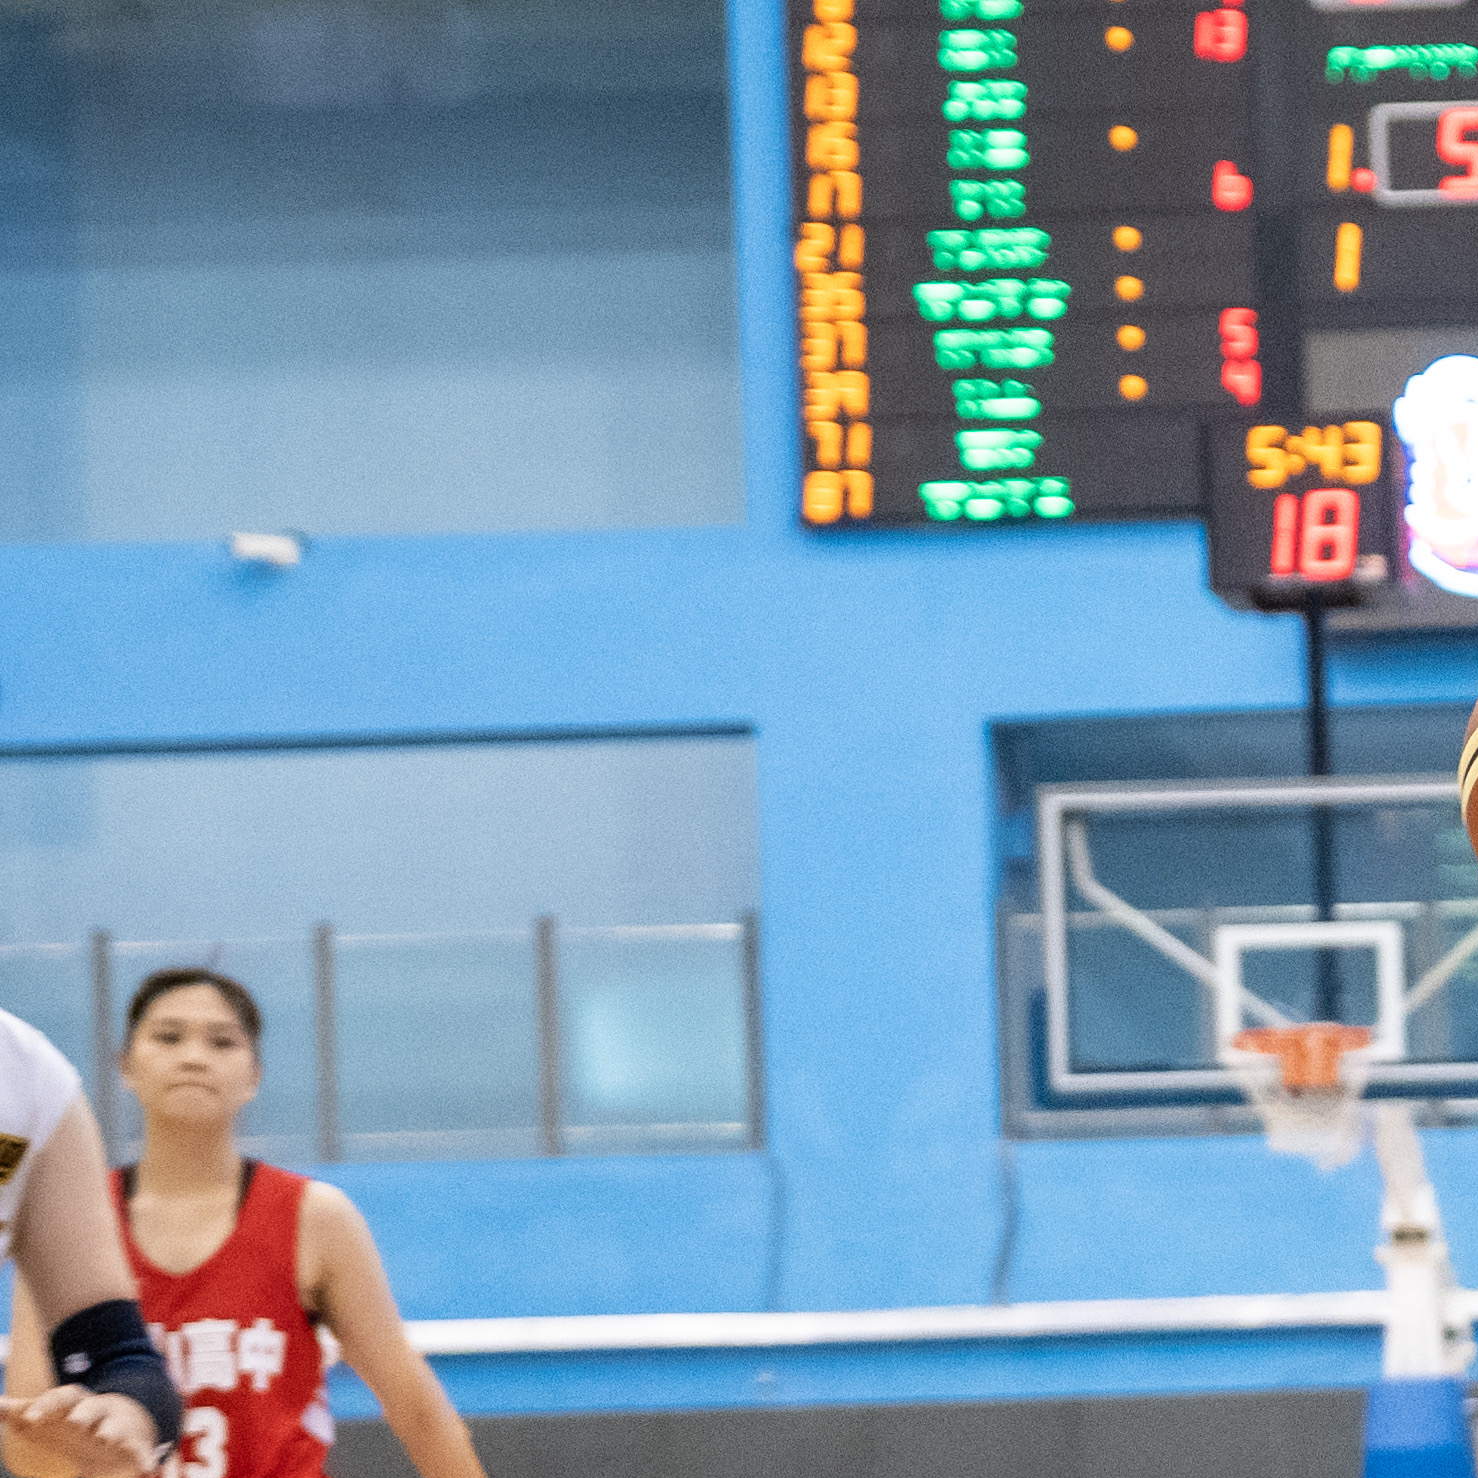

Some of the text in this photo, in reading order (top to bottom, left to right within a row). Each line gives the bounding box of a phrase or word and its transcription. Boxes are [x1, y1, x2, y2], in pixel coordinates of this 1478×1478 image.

[1212, 160, 1254, 211] 6
[1327, 124, 1353, 191] 1
[794, 222, 865, 272] 21
[1335, 222, 1362, 291] 1
[1219, 307, 1259, 359] 5
[1246, 421, 1382, 489] 5:43
[1271, 488, 1360, 582] 18
